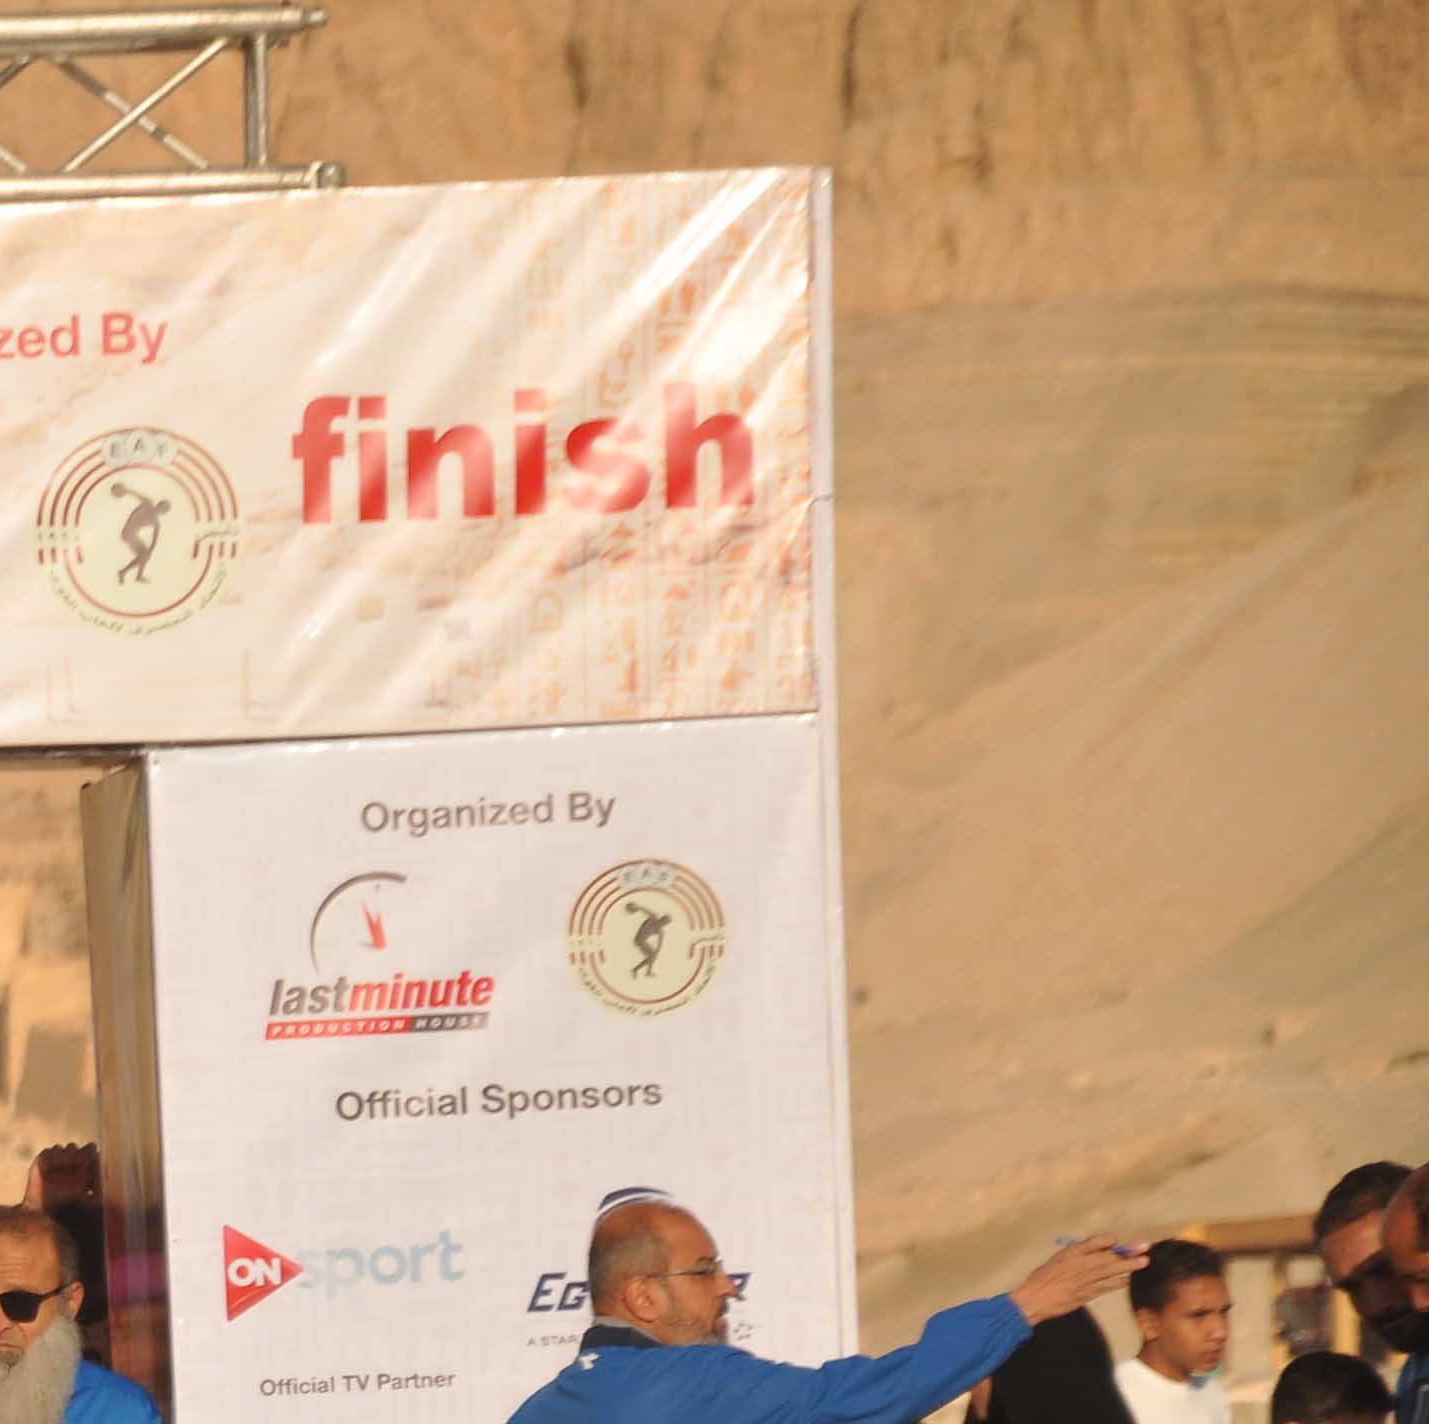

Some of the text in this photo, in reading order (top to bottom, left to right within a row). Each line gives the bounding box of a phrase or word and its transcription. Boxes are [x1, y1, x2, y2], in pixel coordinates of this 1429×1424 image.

[100, 311, 169, 366] By
[291, 382, 756, 526] finish
[360, 791, 616, 838] Organized By
[268, 970, 496, 1018] lastminute
[271, 1013, 488, 1038] PRODUCTION HOUSE
[335, 1080, 664, 1122] Official Sponsors
[227, 1230, 466, 1296] ON sport
[259, 1370, 457, 1397] Official TV Partner
